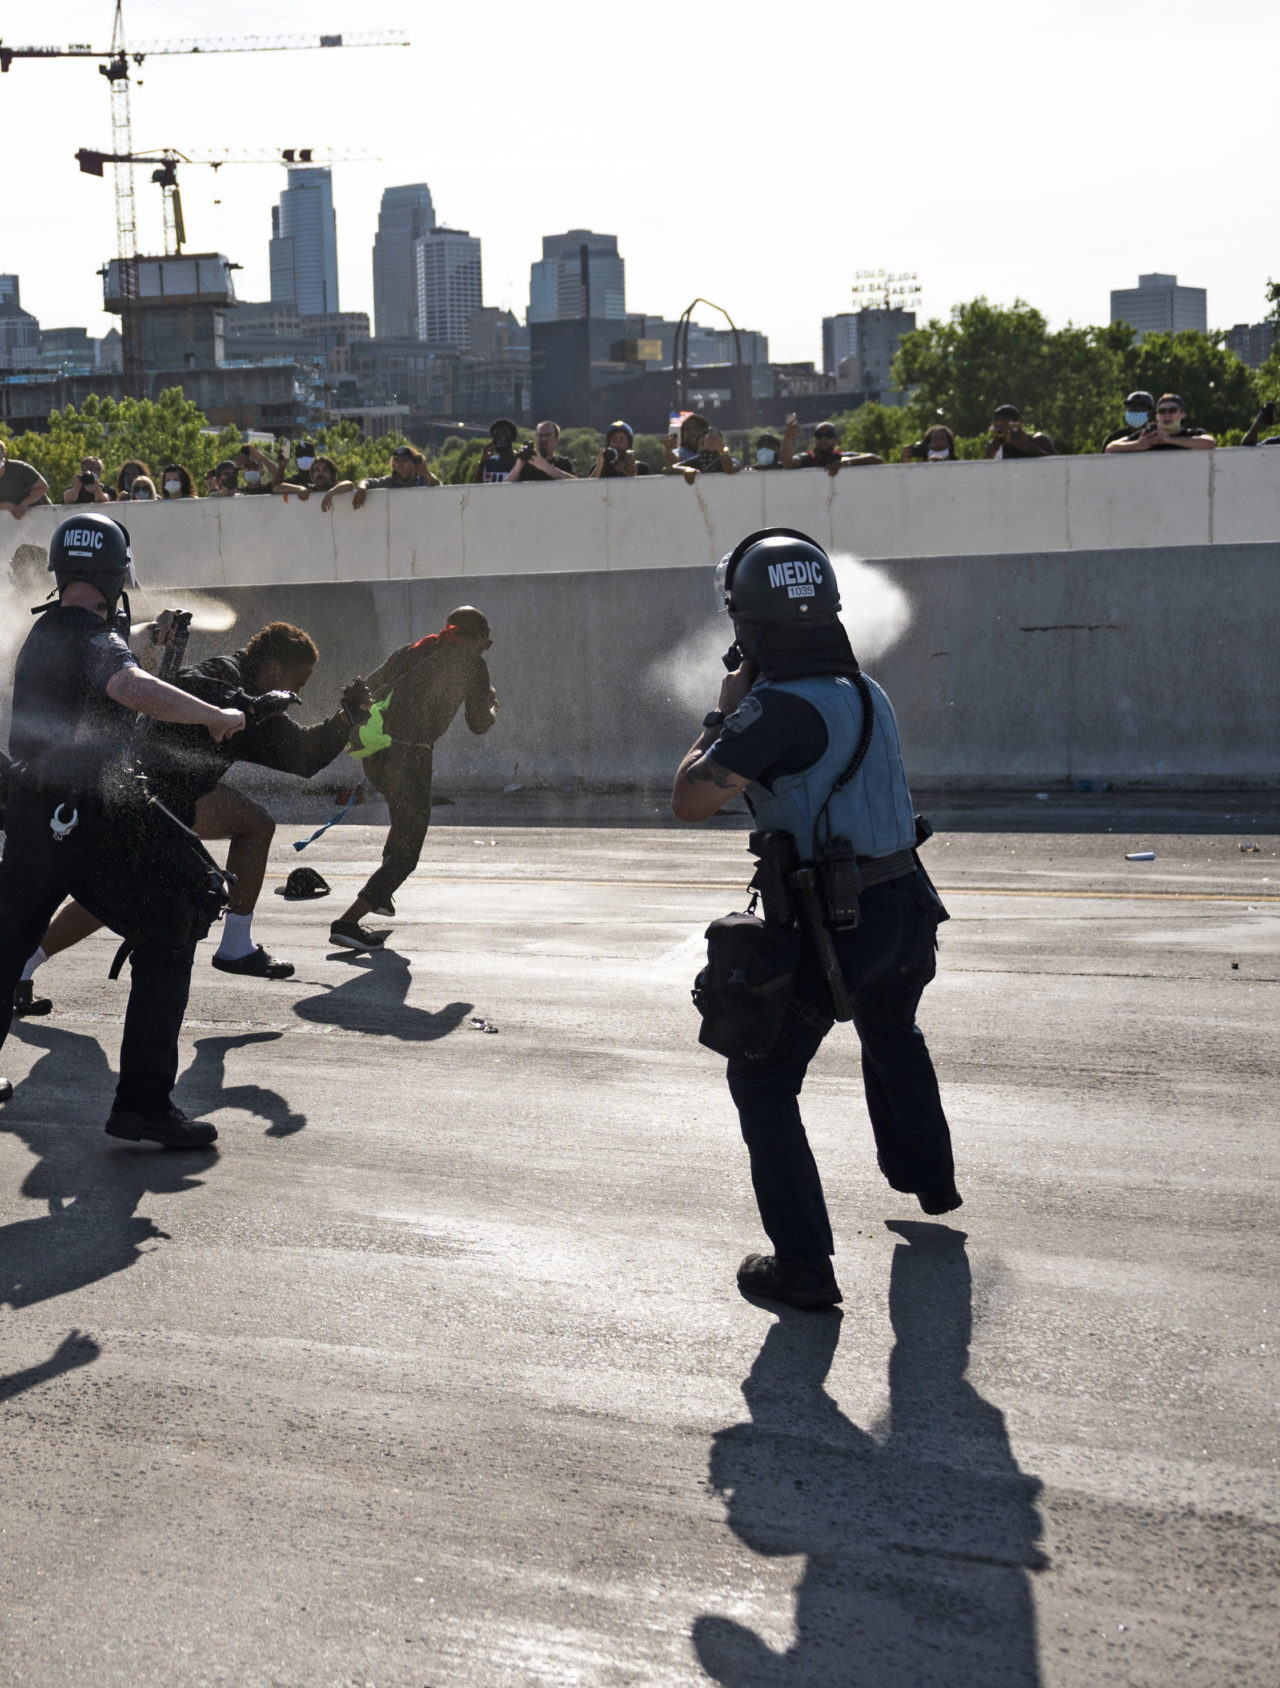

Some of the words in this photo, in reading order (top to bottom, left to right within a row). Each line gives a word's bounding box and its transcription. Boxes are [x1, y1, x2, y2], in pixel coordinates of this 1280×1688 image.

[64, 529, 104, 549] MEDIC
[768, 561, 822, 588] MEDIC
[790, 586, 813, 596] 1035
